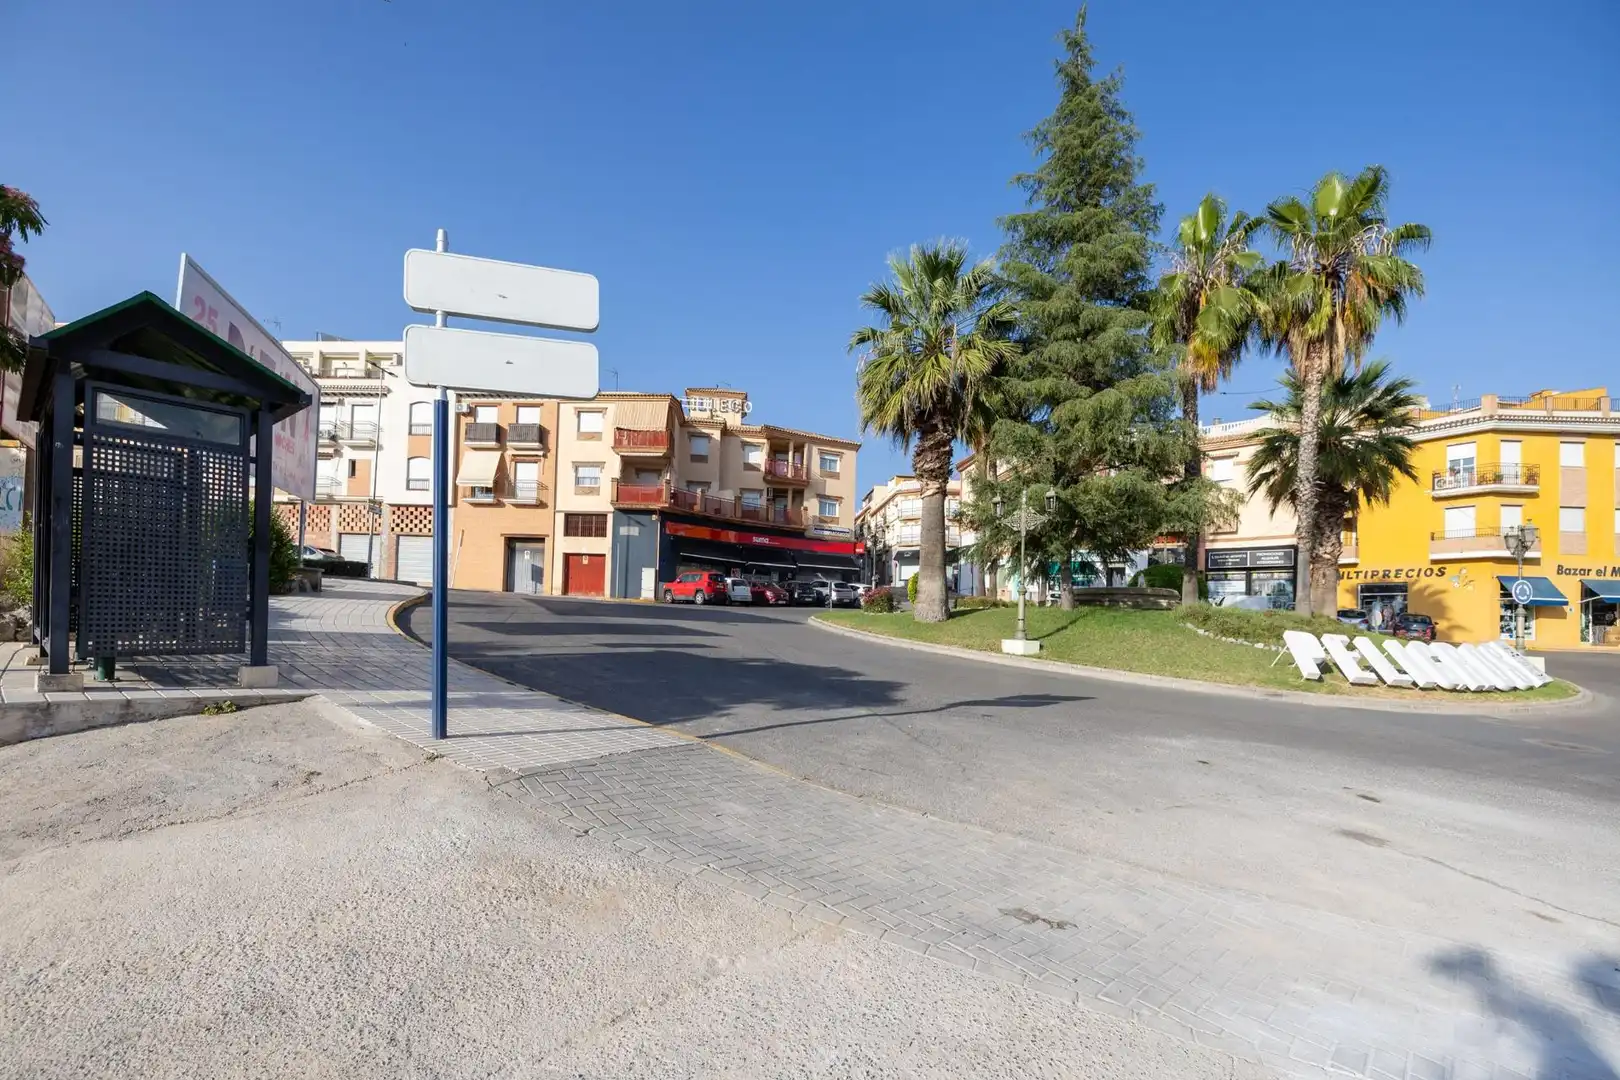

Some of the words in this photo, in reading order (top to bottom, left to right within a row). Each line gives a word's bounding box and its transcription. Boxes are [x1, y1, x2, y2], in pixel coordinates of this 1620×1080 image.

[752, 536, 769, 544] suma
[1557, 564, 1592, 576] Bazar
[1596, 565, 1608, 577] el
